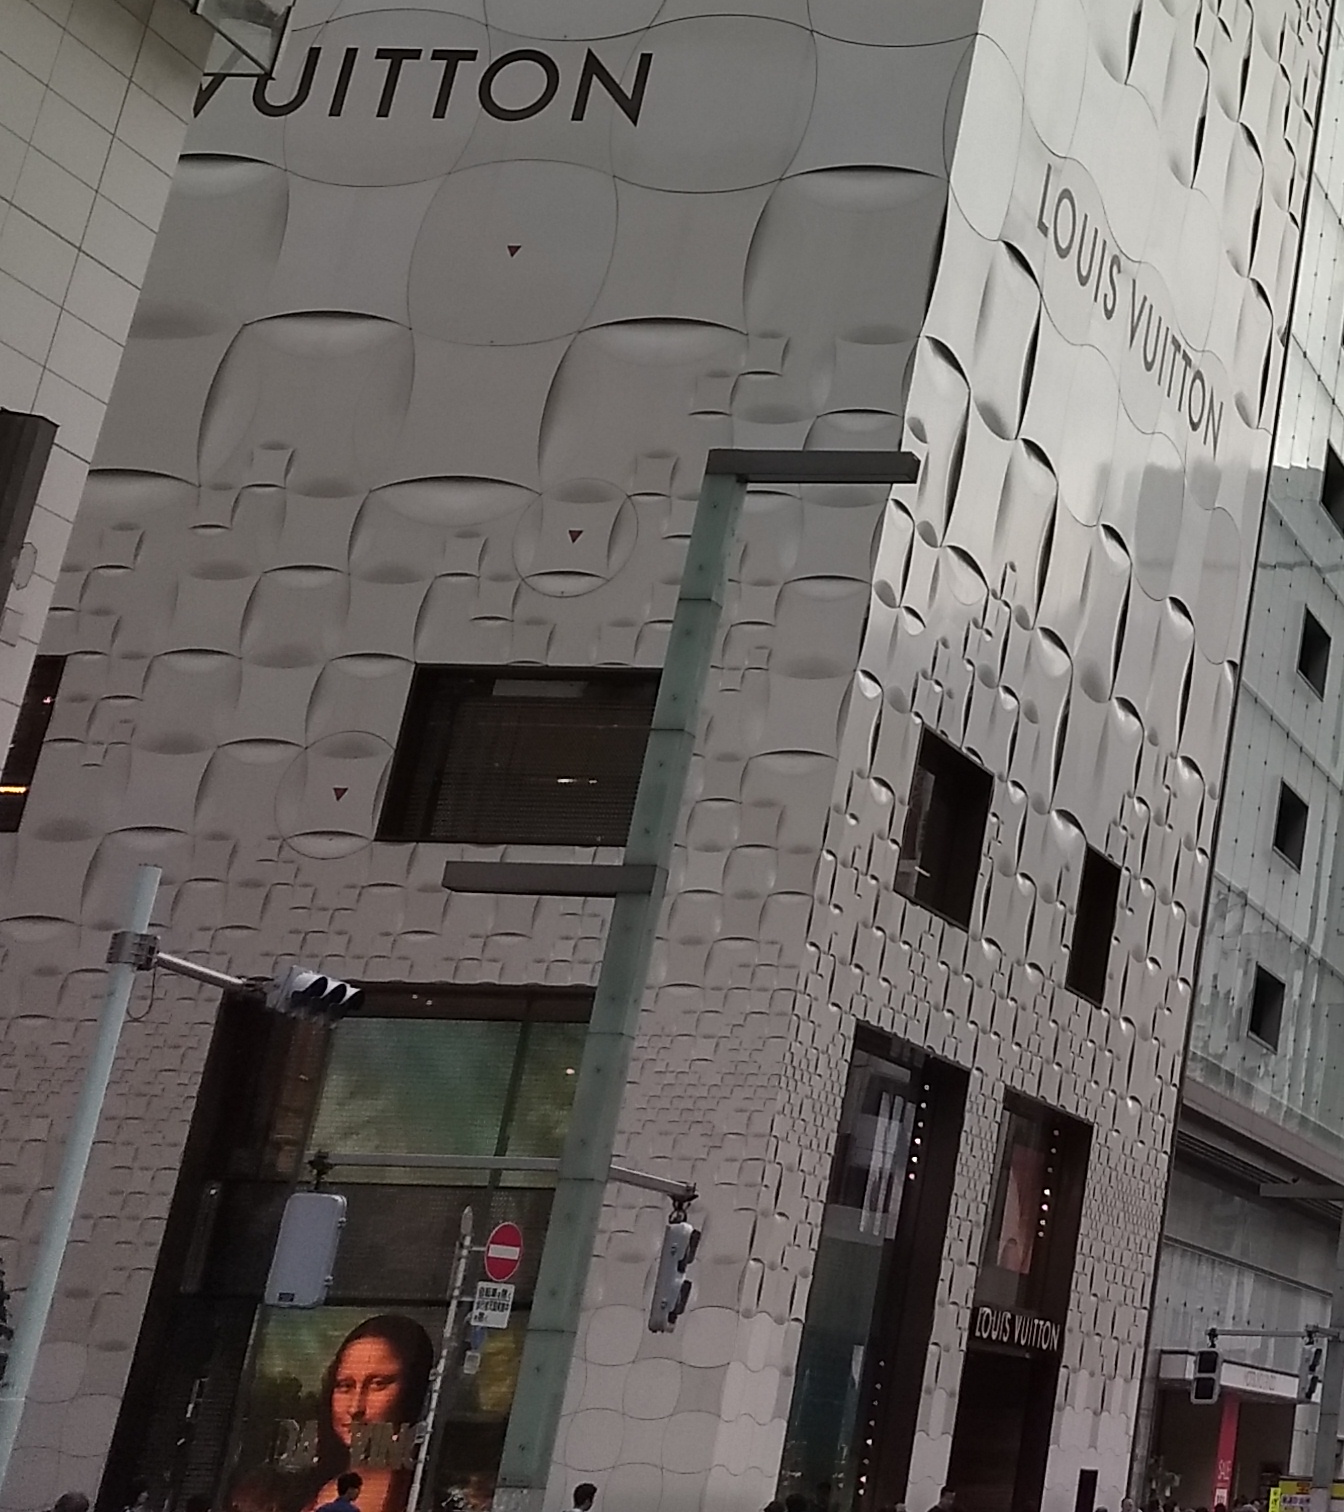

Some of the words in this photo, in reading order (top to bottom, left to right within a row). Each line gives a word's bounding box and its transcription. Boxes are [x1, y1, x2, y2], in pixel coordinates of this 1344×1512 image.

[1036, 163, 1123, 322] LOUIS
[1126, 277, 1225, 460] VUITTON
[975, 1307, 1012, 1343] LOUIS
[1014, 1314, 1060, 1352] VUITTON
